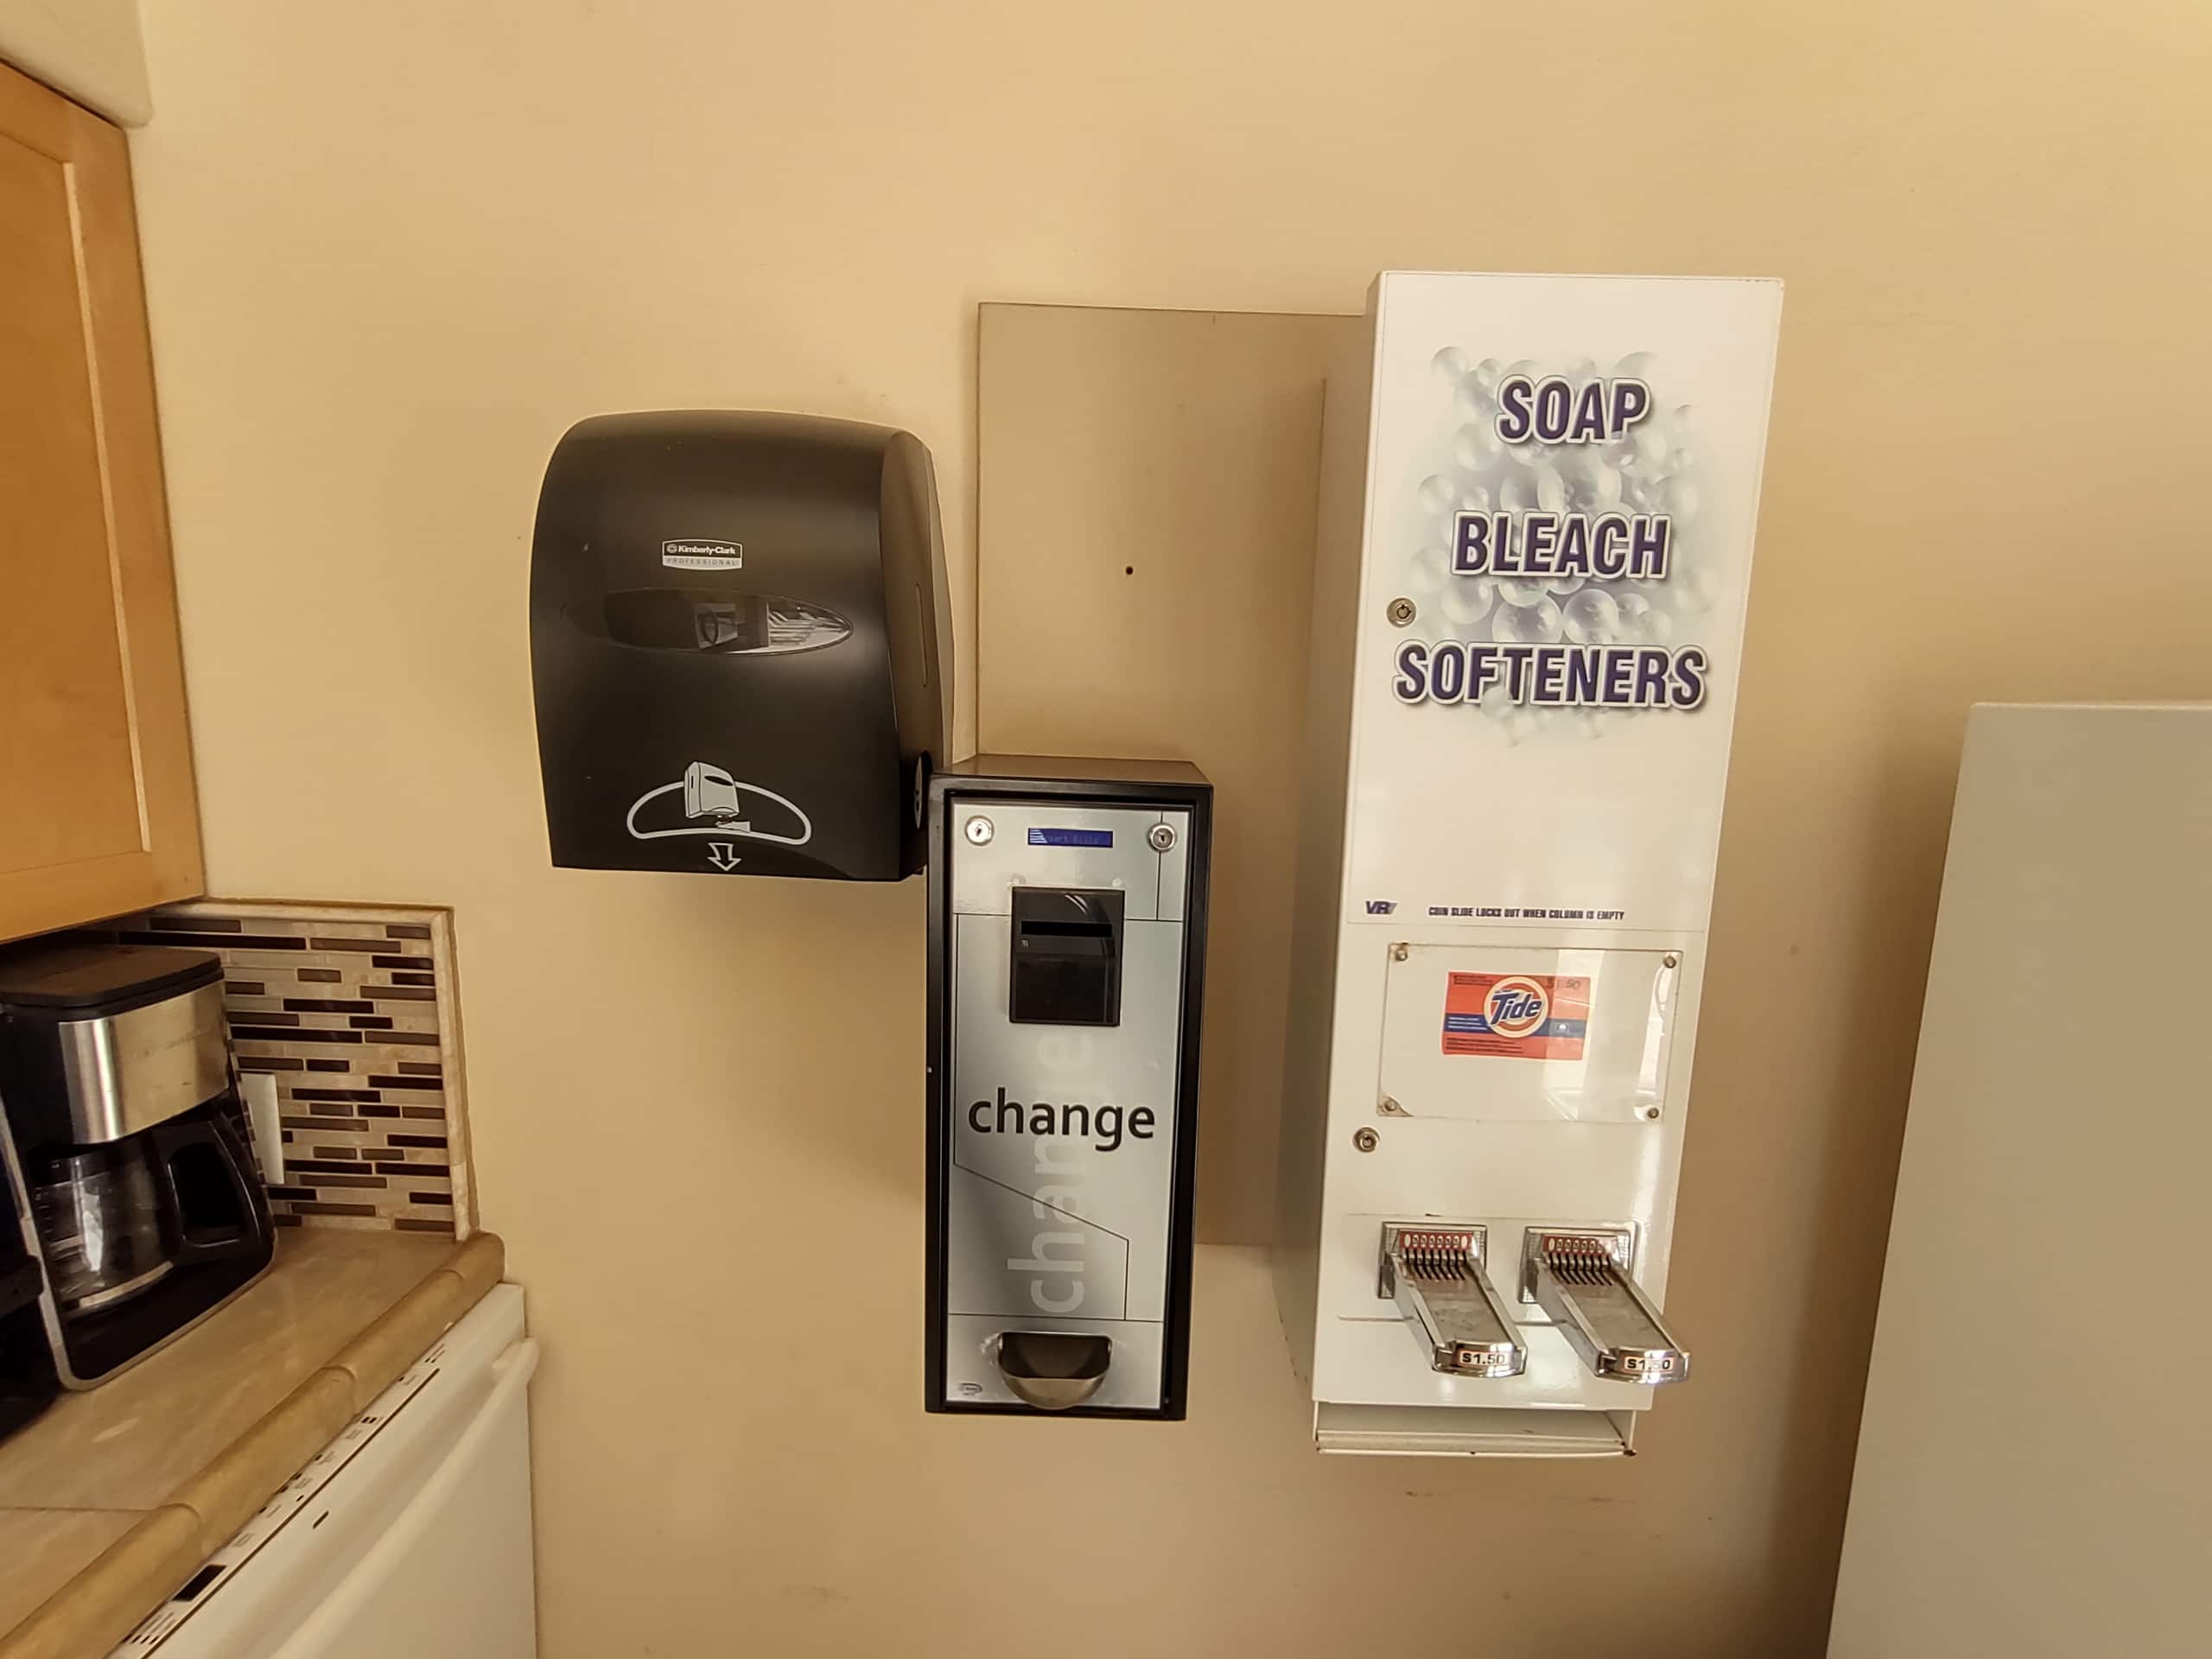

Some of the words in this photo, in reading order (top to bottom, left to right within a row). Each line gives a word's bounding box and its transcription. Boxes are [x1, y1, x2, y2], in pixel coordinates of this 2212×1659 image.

[1497, 377, 1649, 442] SOAP
[677, 545, 736, 556] Kimberly-Clark
[1453, 513, 1670, 577] BLEACH
[1395, 642, 1707, 708] SOFTENERS
[1451, 907, 1473, 917] SLIDE
[1476, 907, 1502, 917] LOCKS
[1504, 908, 1521, 918] OUT
[1522, 909, 1547, 918] WHEN
[1548, 909, 1584, 918] COLUMN
[1586, 910, 1595, 919] IS
[1596, 911, 1625, 920] EMPTY
[1490, 992, 1542, 1025] Tide
[968, 1086, 1156, 1152] change
